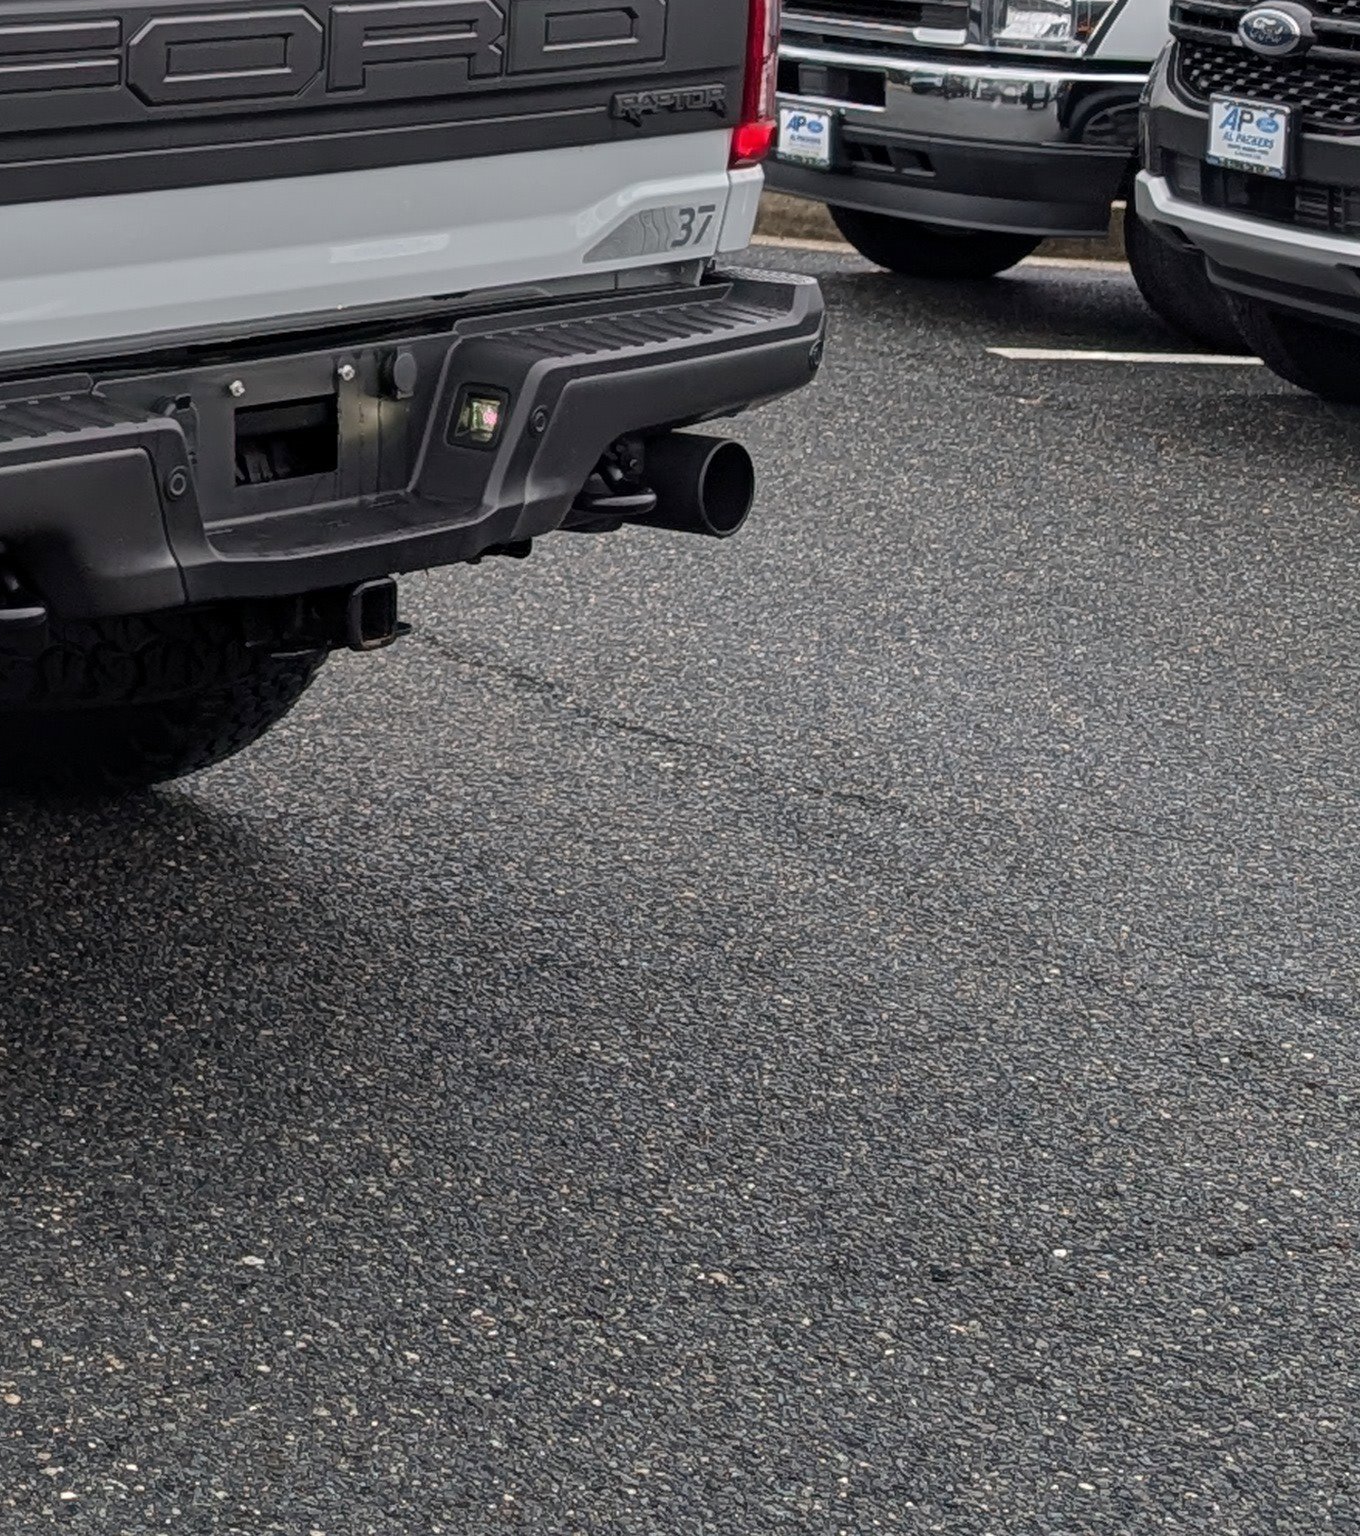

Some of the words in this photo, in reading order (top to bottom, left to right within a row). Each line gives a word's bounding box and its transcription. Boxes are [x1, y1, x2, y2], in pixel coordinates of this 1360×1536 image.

[611, 82, 726, 126] RAPTOR
[1220, 106, 1254, 132] AP
[671, 204, 716, 248] 37
